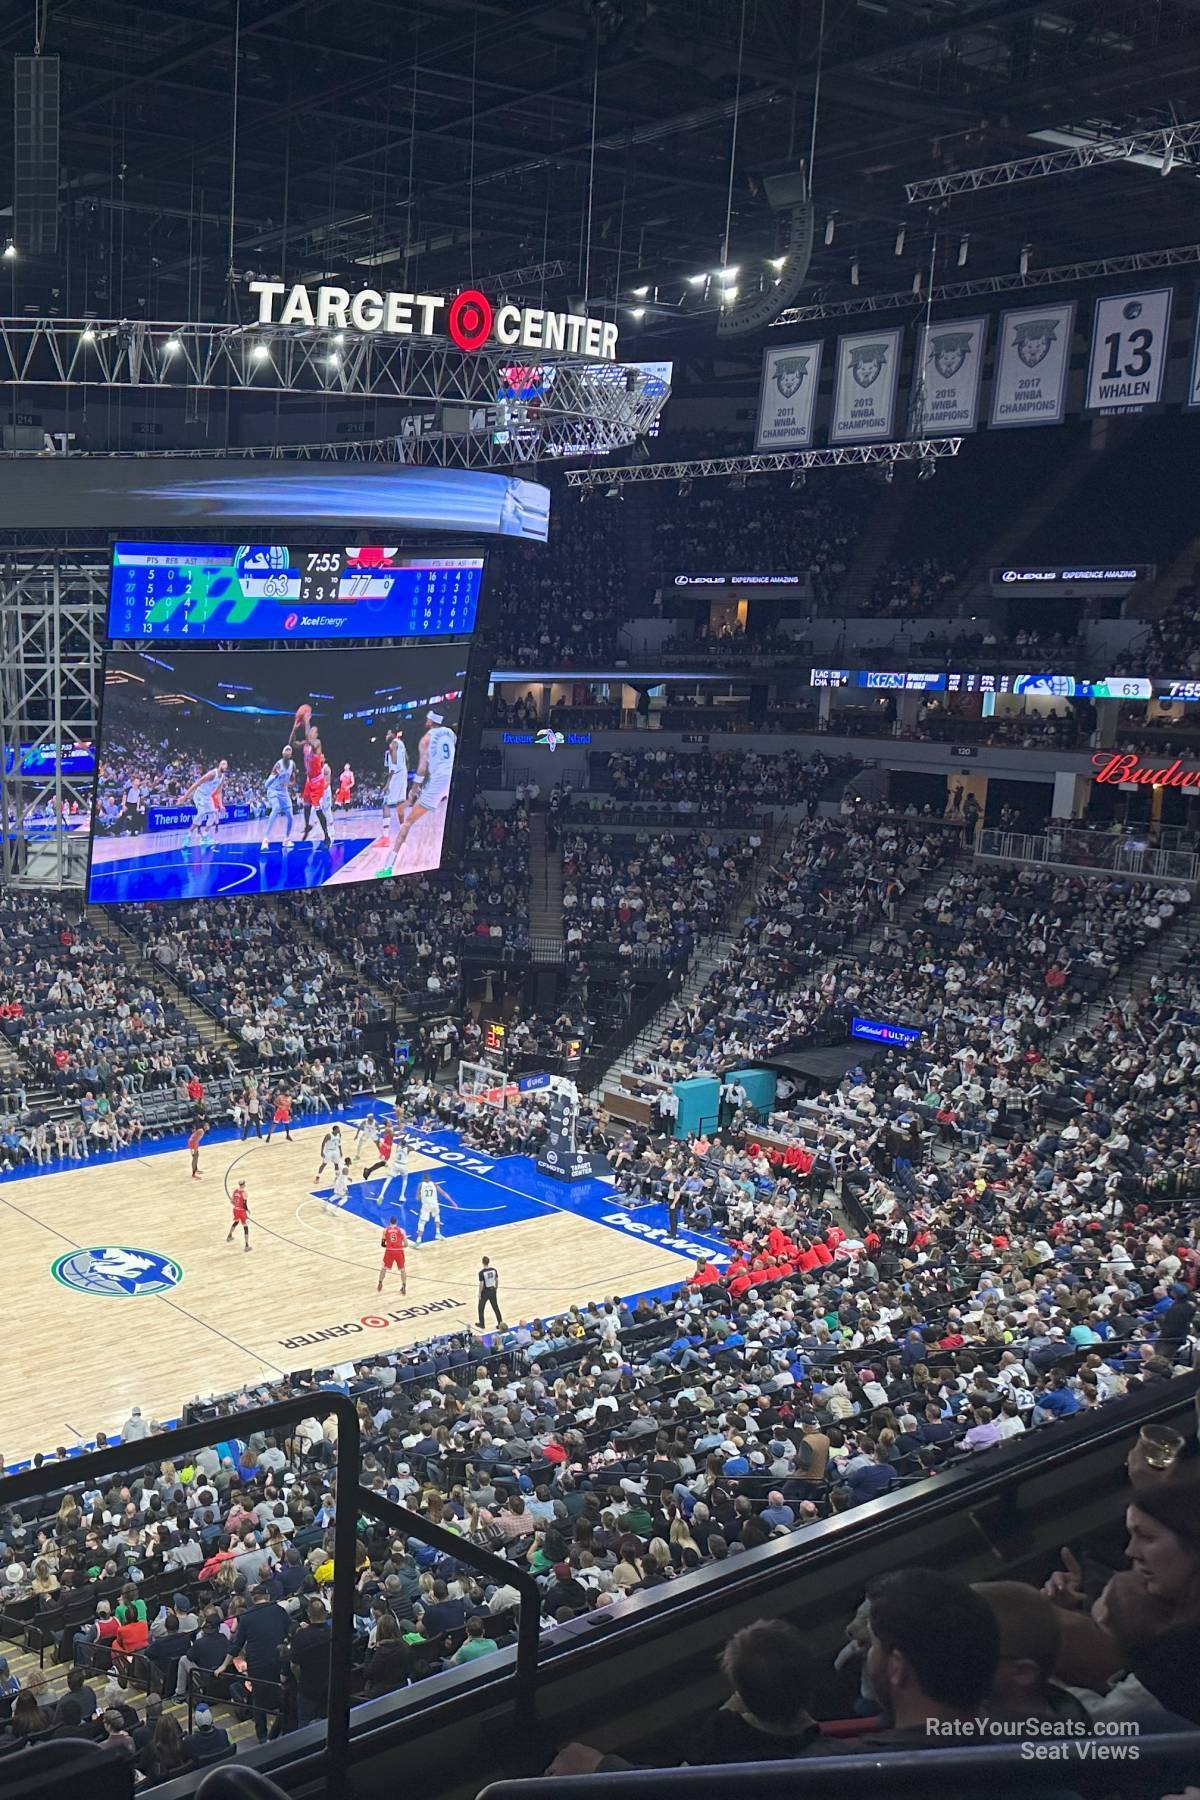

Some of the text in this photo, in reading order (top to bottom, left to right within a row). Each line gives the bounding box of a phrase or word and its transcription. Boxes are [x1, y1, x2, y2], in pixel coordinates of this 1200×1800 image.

[248, 281, 619, 360] TARGET CENTER
[1101, 328, 1153, 380] 13
[1018, 378, 1041, 389] 2017
[935, 389, 956, 398] 2015
[1015, 390, 1042, 401] WNBA
[1099, 381, 1151, 399] WHALEN
[854, 398, 873, 407] 2013
[931, 400, 957, 410] WNBA
[1000, 400, 1056, 414] CHAMPIONS
[777, 408, 794, 417] 2011
[850, 408, 874, 418] WNBA
[773, 418, 796, 427] WNBA
[838, 418, 885, 430] CHAMPIONS
[762, 427, 806, 439] CHAMPIONS
[307, 553, 341, 572] 7:55
[148, 570, 155, 579] 5
[1062, 571, 1104, 579] EXPERIENCE
[1104, 570, 1136, 578] AMAZING
[147, 584, 154, 593] 5
[264, 574, 288, 596] 63
[350, 574, 372, 596] 77
[316, 587, 324, 600] 3
[329, 589, 336, 599] 4
[144, 597, 155, 607] 16
[144, 610, 152, 620] 7
[143, 623, 152, 633] 13
[815, 670, 829, 678] LAC
[814, 679, 827, 687] CHA
[867, 673, 905, 688] KFAN
[1123, 684, 1140, 695] 63
[503, 732, 592, 744] Treasure Island
[443, 743, 450, 760] 9
[155, 814, 179, 825] There
[180, 812, 191, 823] for
[601, 1212, 733, 1265] betway
[278, 1298, 467, 1349] TARGET CENTER
